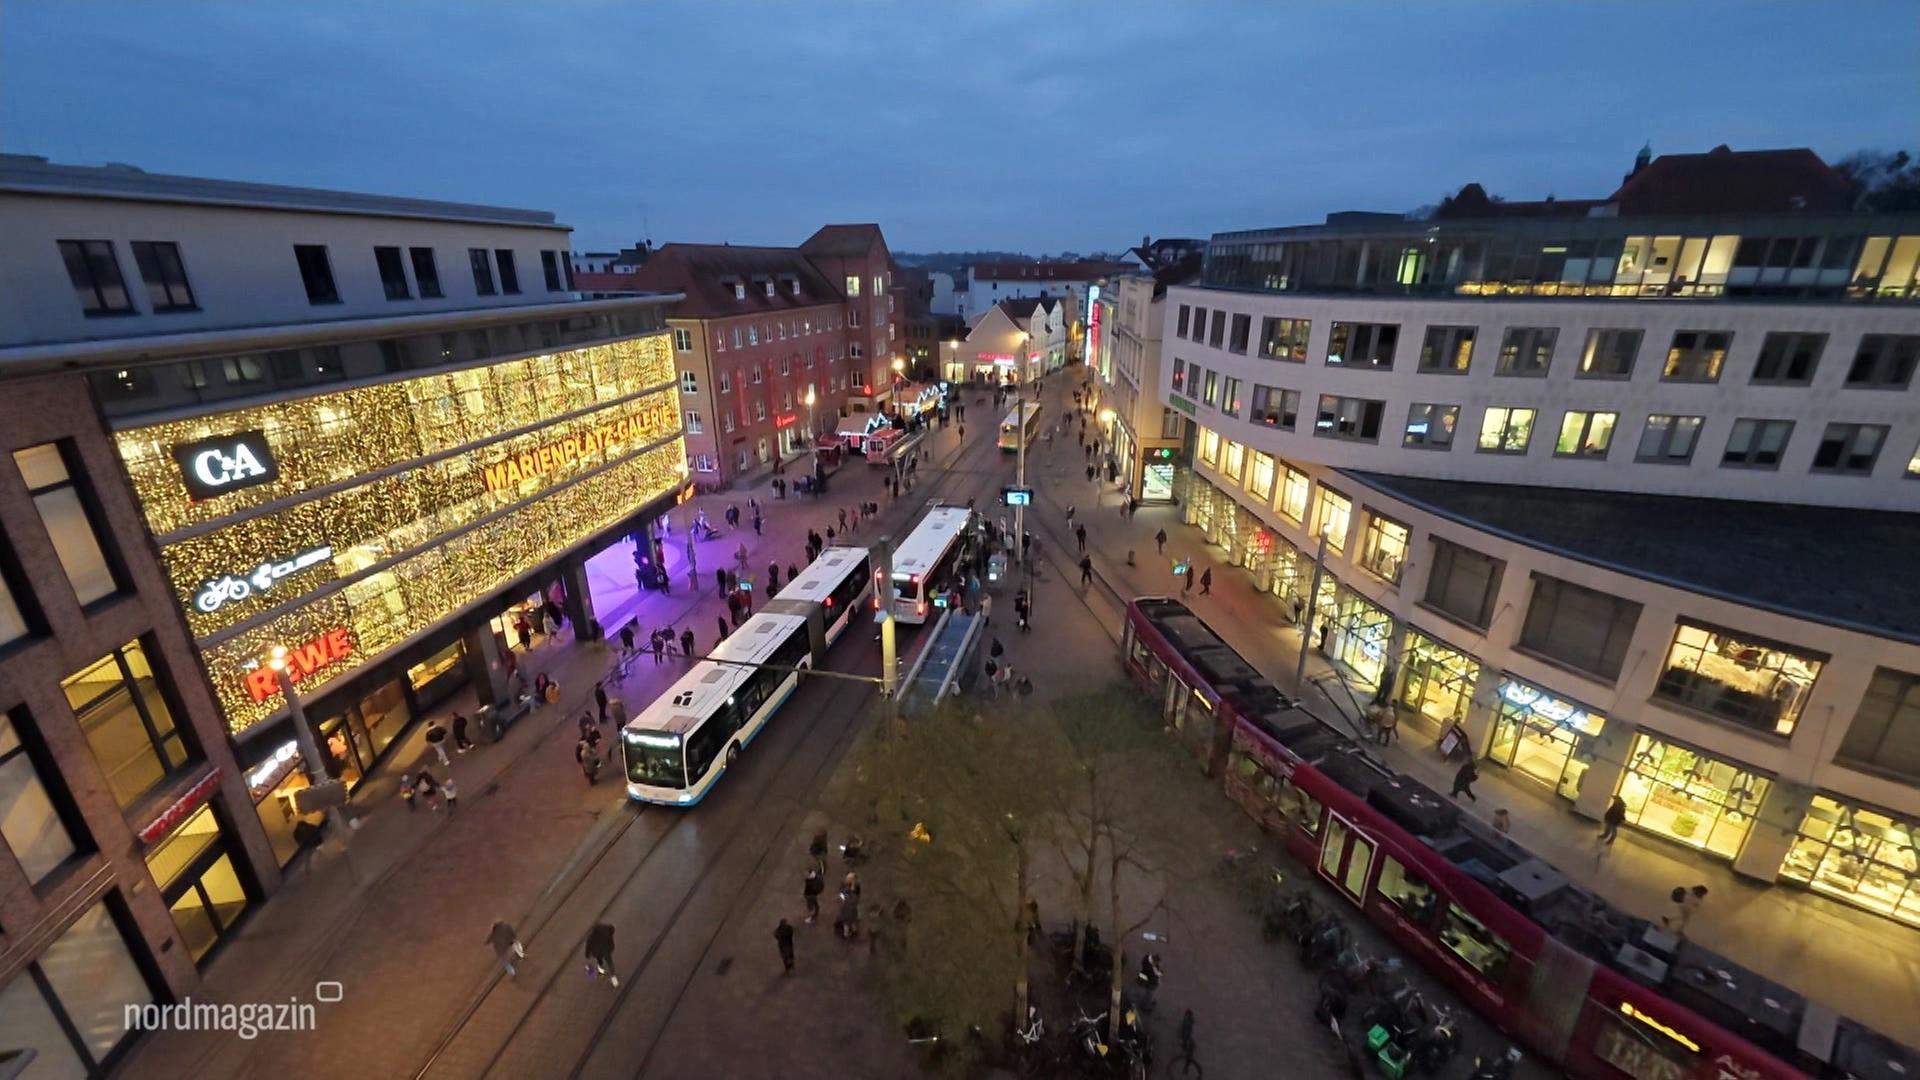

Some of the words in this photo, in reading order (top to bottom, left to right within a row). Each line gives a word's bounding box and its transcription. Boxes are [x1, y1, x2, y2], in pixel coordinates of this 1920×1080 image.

[194, 443, 267, 486] C&A
[484, 405, 672, 491] MARIENPLATZ-GALERIE
[245, 627, 352, 702] REWE
